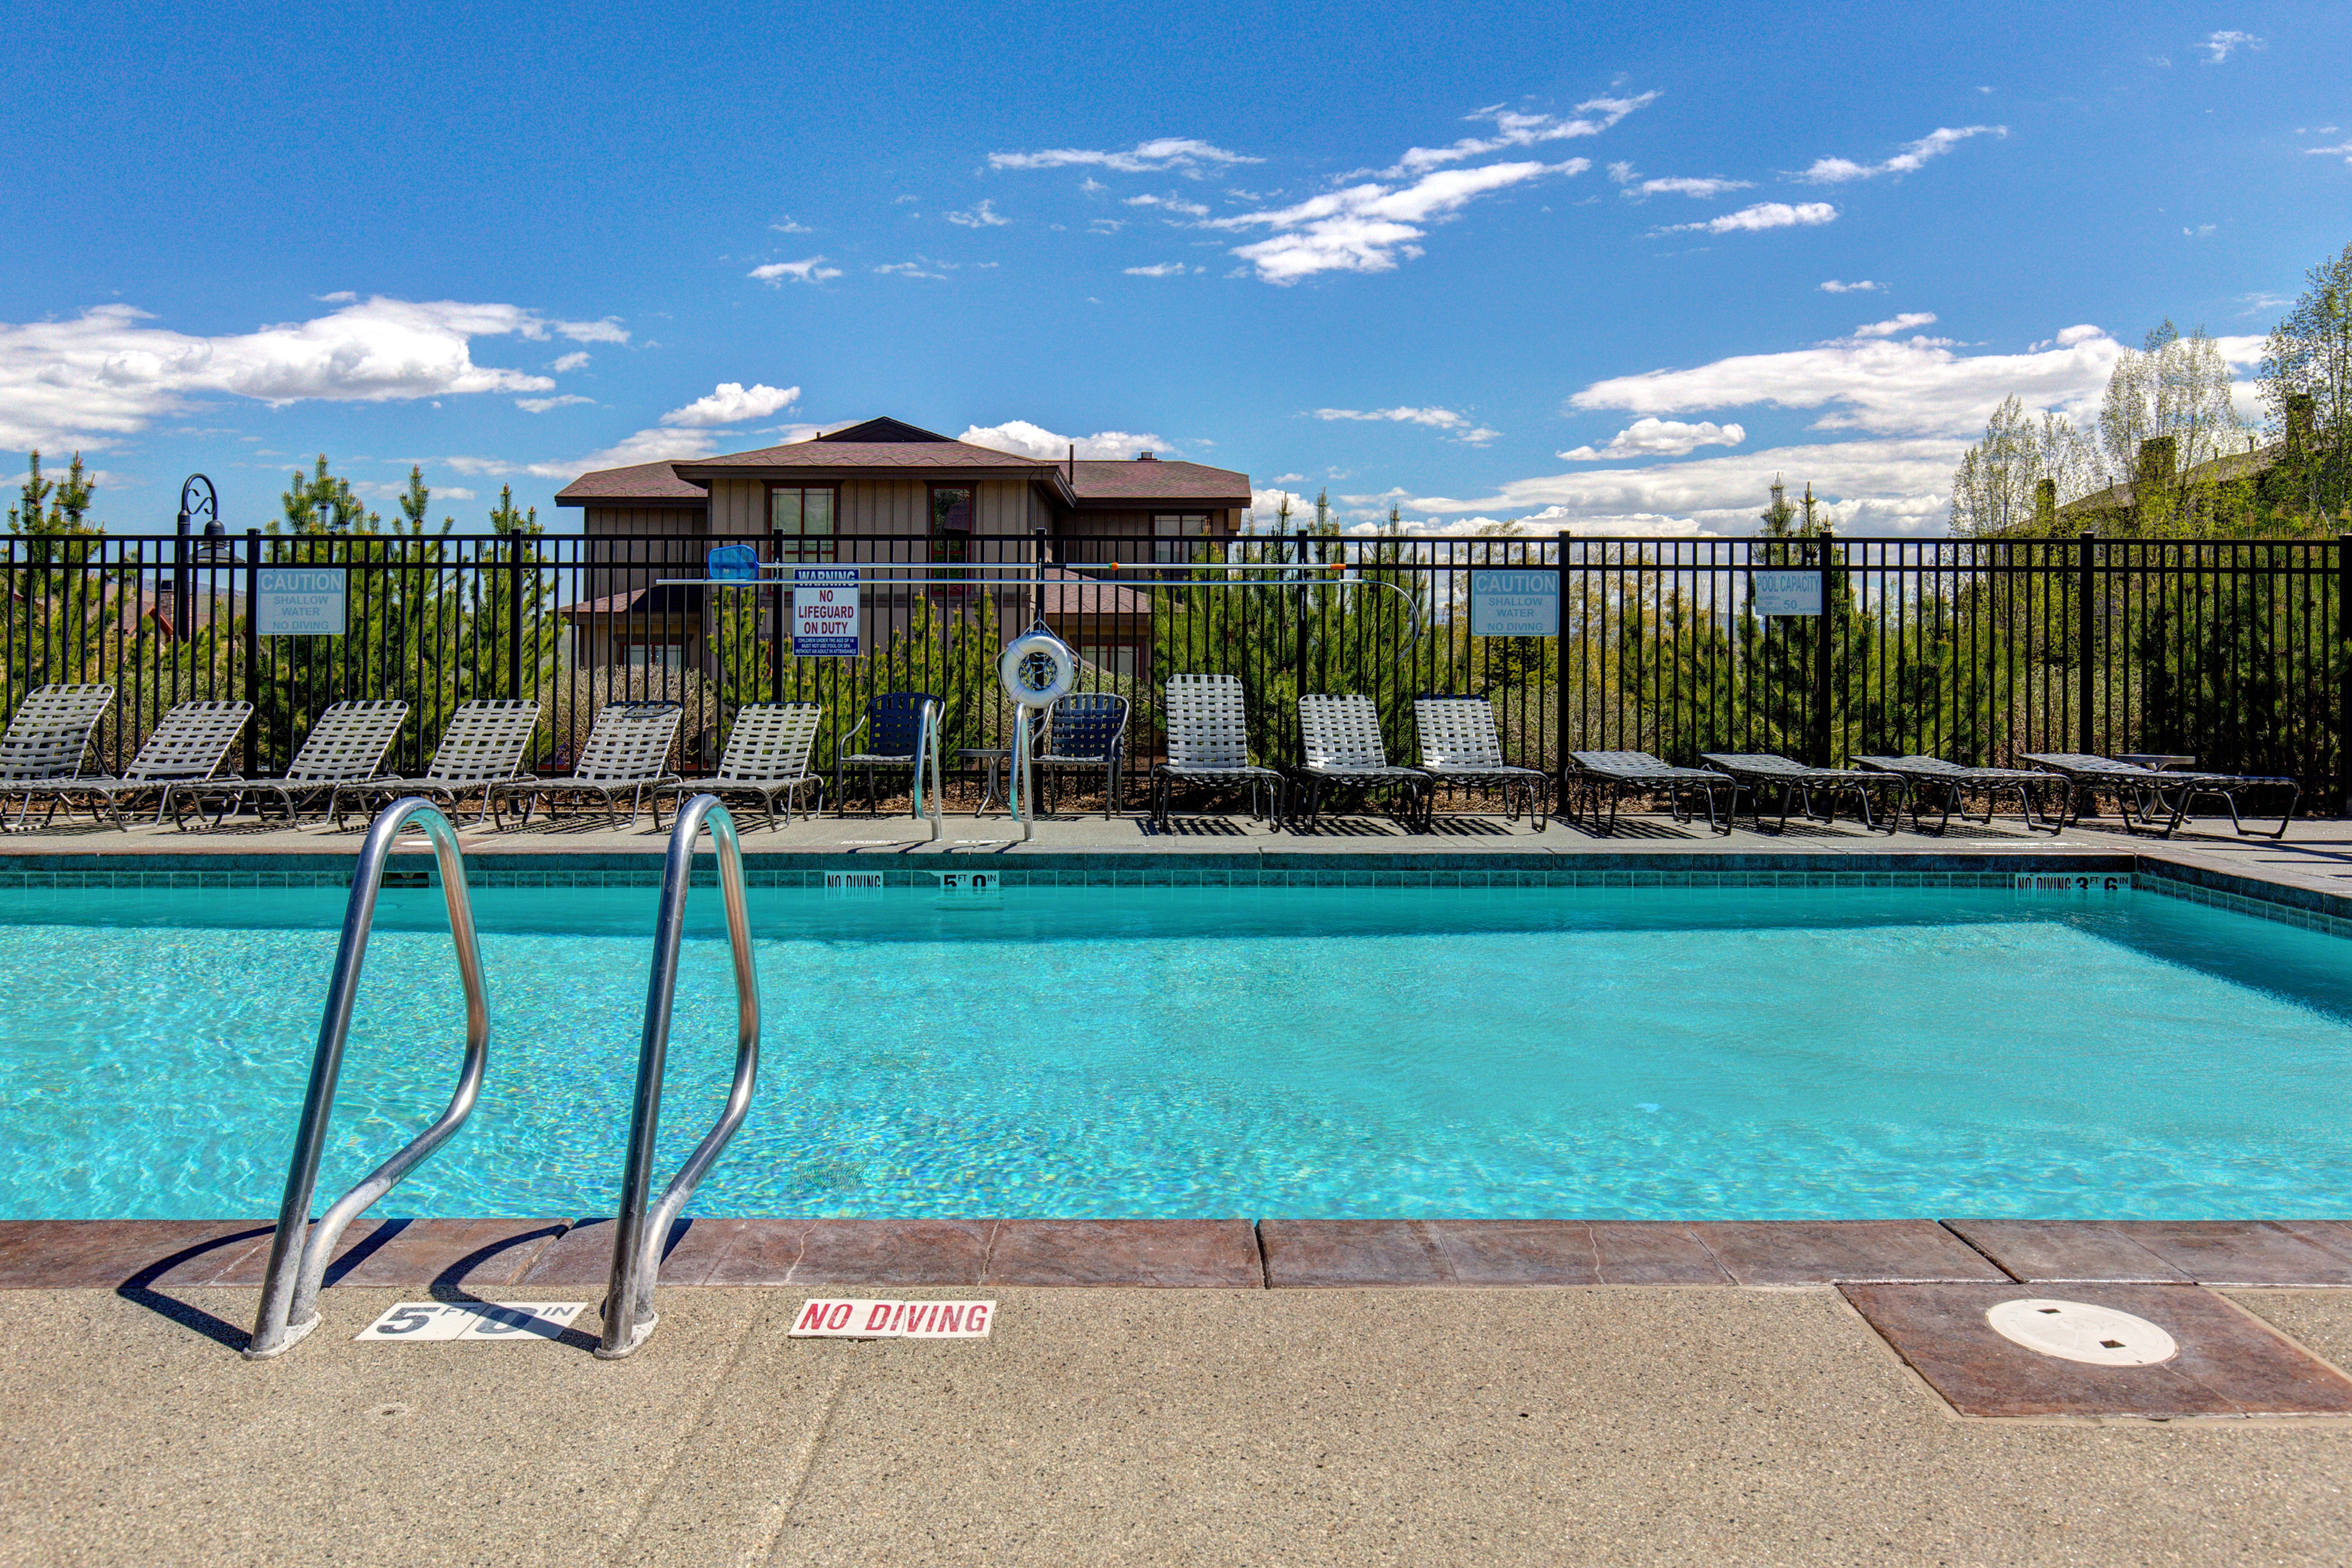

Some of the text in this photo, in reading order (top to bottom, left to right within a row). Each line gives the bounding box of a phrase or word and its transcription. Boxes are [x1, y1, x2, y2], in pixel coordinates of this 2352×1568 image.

[261, 574, 342, 590] CAUTION
[798, 571, 855, 586] WARNING
[1476, 575, 1556, 592] CAUTION
[1757, 575, 1819, 592] POOL CAPACITY
[274, 596, 329, 604] SHALLOW
[819, 590, 833, 602] NO
[1489, 598, 1543, 606] SHALLOW
[1784, 600, 1797, 610] 50
[282, 607, 320, 616] WATER
[798, 606, 854, 619] LIFEGUARD
[1497, 609, 1534, 618] WATER
[273, 621, 329, 630] NO DIVING
[804, 622, 848, 634] ON DUTY
[827, 875, 880, 888] NO DIVING
[2018, 877, 2071, 890] NO DIVING
[798, 1303, 988, 1333] NO DIVING
